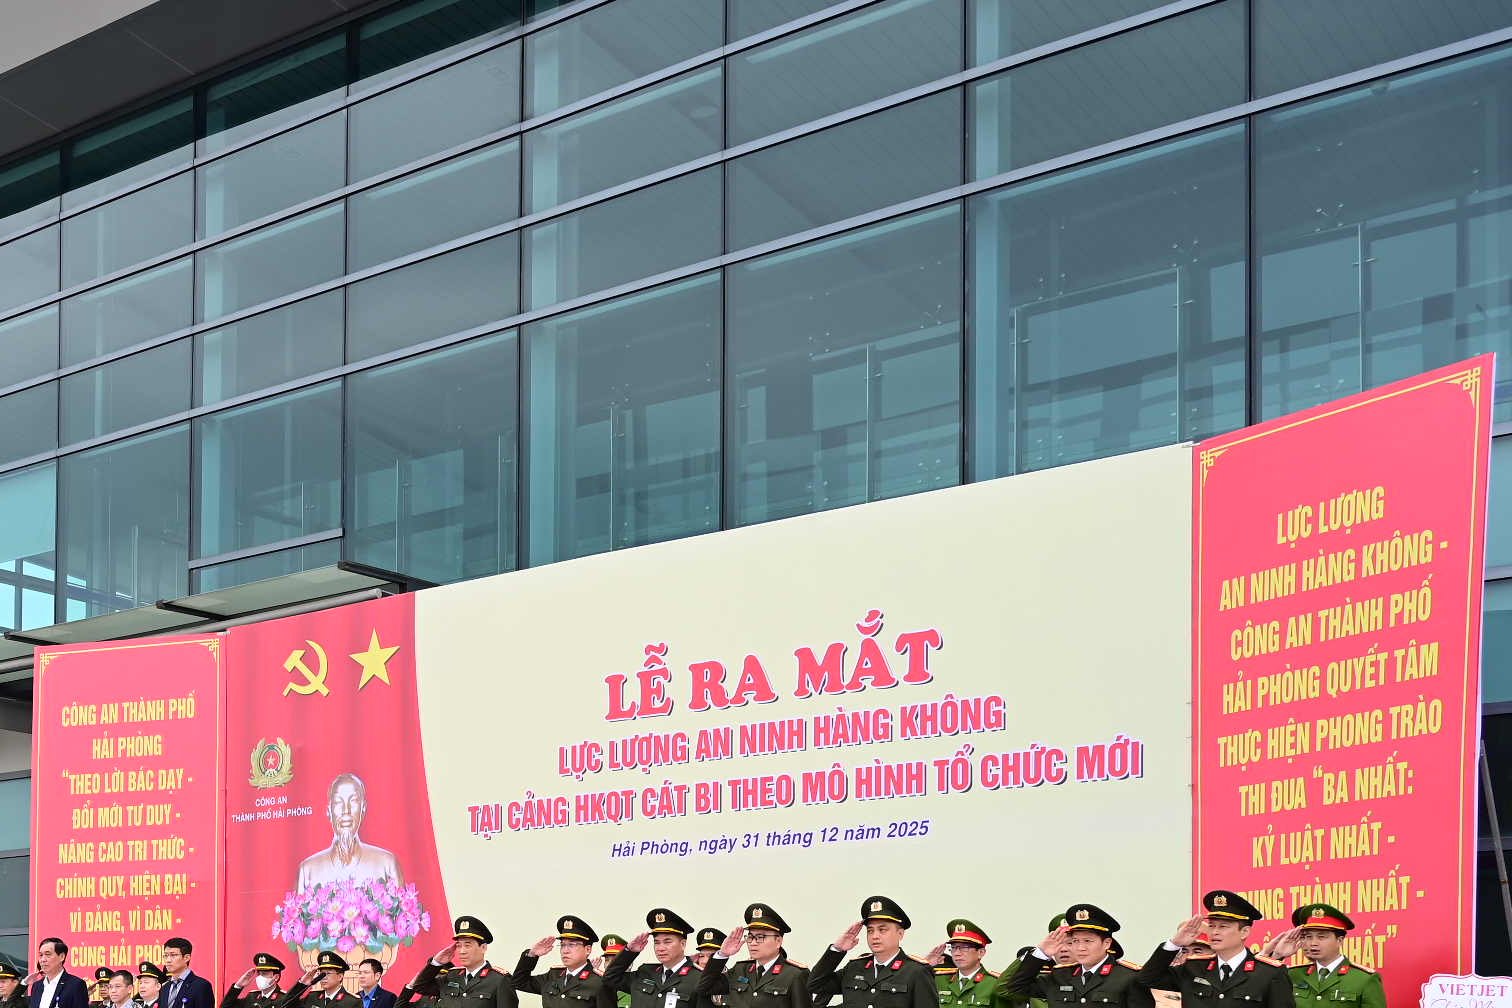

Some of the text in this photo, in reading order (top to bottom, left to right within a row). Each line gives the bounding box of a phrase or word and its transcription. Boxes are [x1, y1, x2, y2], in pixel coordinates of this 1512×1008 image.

[1276, 486, 1384, 549] LỰC LƯỢNG
[1219, 576, 1245, 611] AN
[1250, 563, 1296, 604] NINH
[1301, 548, 1356, 592] HÀNG
[1361, 529, 1434, 578] KHÔNG
[1230, 574, 1433, 661] CÔNG AN THÀNH PHỐ
[604, 608, 943, 722] LỄ RA MẮT
[1222, 638, 1440, 715] HẢI PHÒNG QUYẾT TÂM
[61, 690, 196, 728] CÔNG AN THÀNH PHỐ
[92, 730, 162, 760] HẢI PHÒNG
[558, 693, 1006, 781] LỰC LƯỢNG AN NINH HÀNG KHÔNG
[1218, 694, 1443, 772] THỰC HIỆN PHONG TRÀO
[104, 766, 124, 793] LỜI
[128, 766, 155, 792] BÁC
[158, 768, 184, 794] DẠY
[468, 734, 1144, 840] TẠI CẢNG HKQT CÁT BI THEO MÔ HÌNH TỔ CHỨC MỚI
[1238, 750, 1414, 817] THI ĐUA “BA NHẤT:
[72, 800, 94, 830] ĐỔI
[98, 802, 123, 828] MỚI
[126, 803, 144, 826] TƯ
[146, 804, 172, 826] DUY
[232, 806, 313, 822] THÀNH PHỐ HẢI PHÒNG
[256, 796, 288, 807] CÔNG AN
[58, 838, 94, 864] NÂNG
[99, 840, 124, 862] CAO
[128, 840, 147, 861] TRI
[152, 834, 185, 860] THỨC
[611, 820, 930, 858] Hải Phòng, ngày 31 tháng 12 năm 2025
[1252, 824, 1276, 868] KỶ
[1280, 824, 1325, 870] LUẬT
[1330, 810, 1384, 860] NHẤT
[56, 873, 96, 898] CHÍNH
[100, 876, 126, 900] QUY,
[130, 870, 161, 900] HIỆN
[164, 874, 187, 900] ĐẠI
[1358, 864, 1411, 913] NHẤT
[70, 907, 82, 932] VÌ
[85, 904, 124, 934] ĐẢNG,
[128, 905, 141, 931] VÌ
[144, 904, 172, 930] DÂN
[70, 938, 165, 968] CÙNG HẢI PHÒ
[1438, 984, 1508, 997] VIETJET
